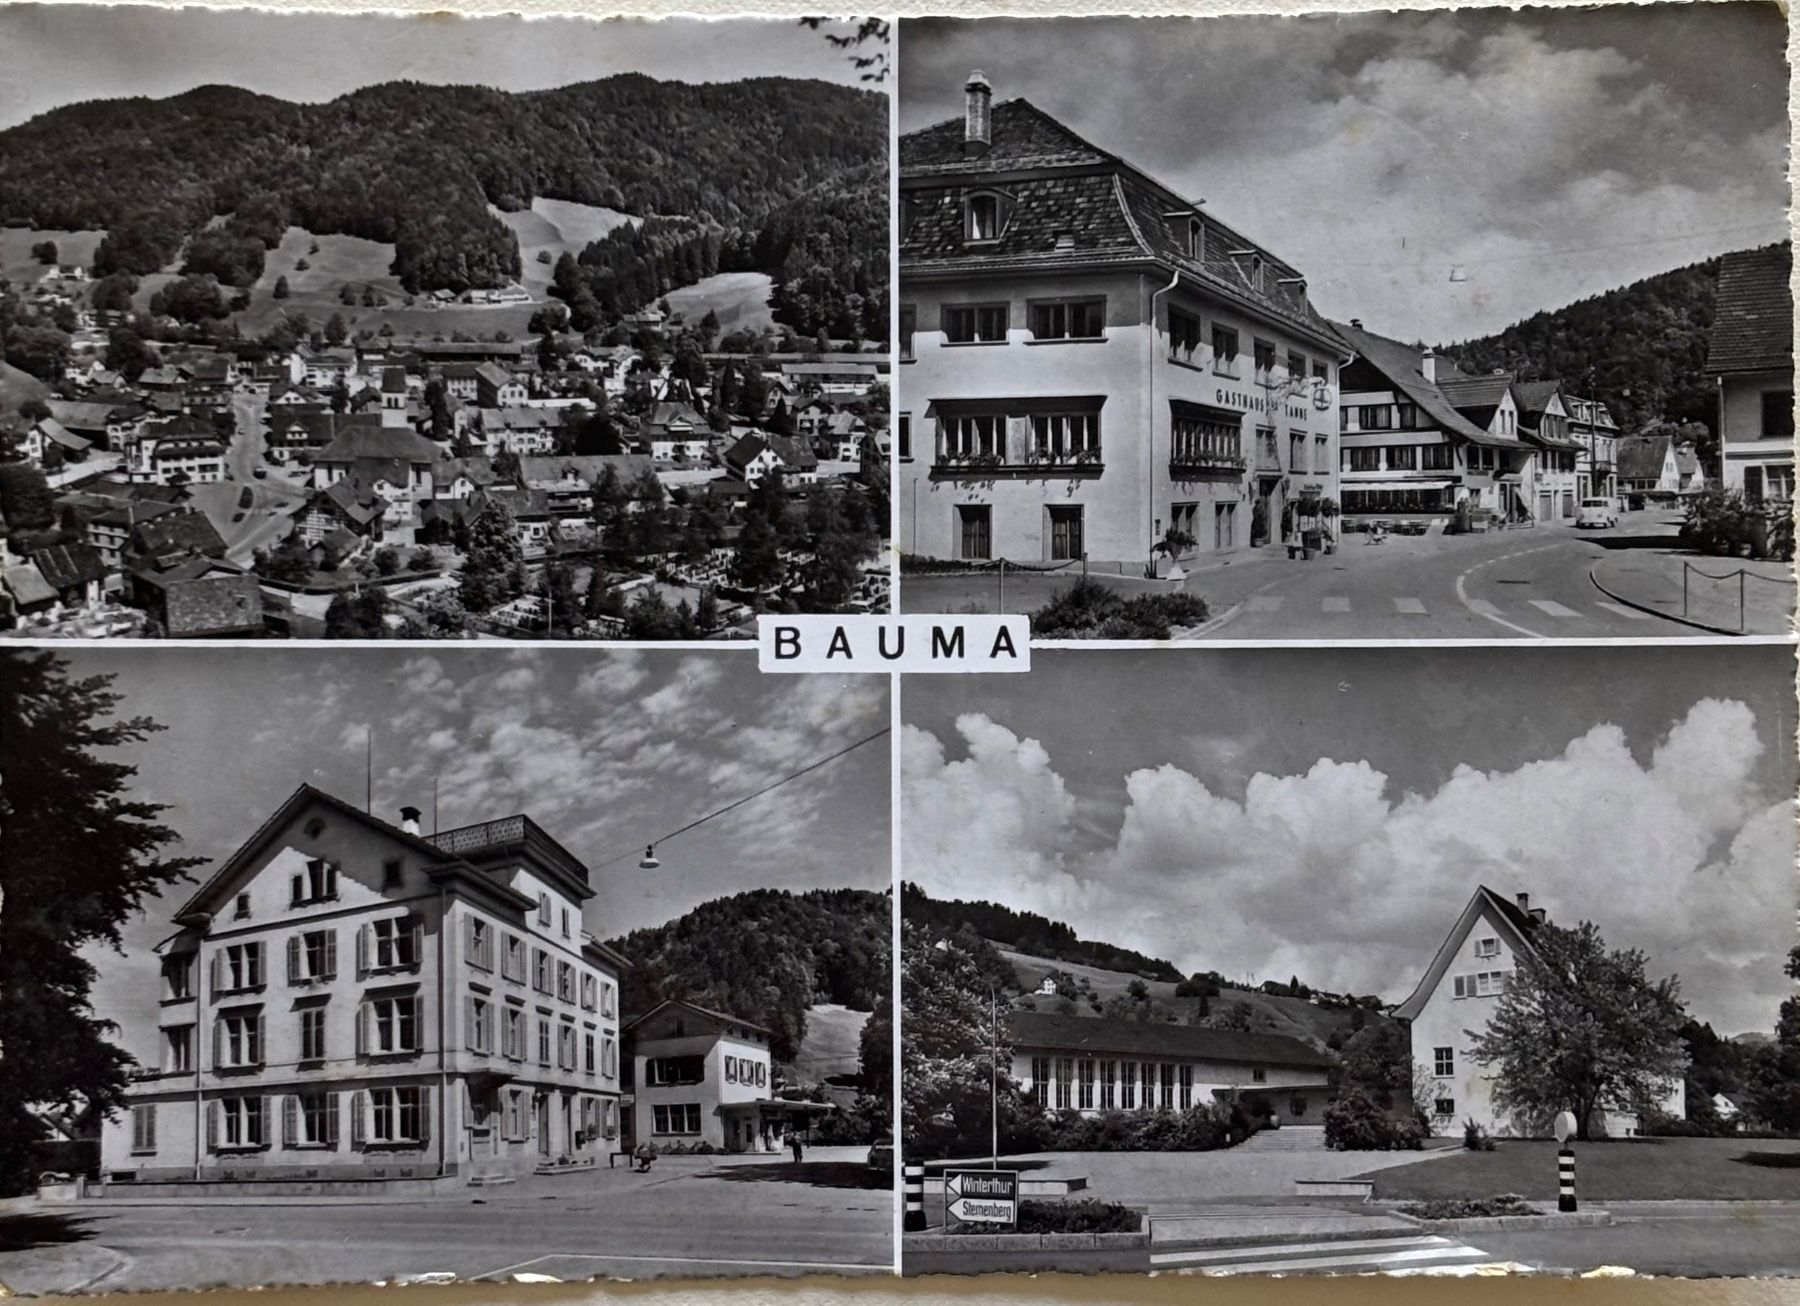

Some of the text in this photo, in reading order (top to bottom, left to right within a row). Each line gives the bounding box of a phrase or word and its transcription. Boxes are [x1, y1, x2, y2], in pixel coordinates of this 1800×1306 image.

[1216, 388, 1264, 412] GASTHAUS
[962, 1176, 1013, 1194] Winterthur
[962, 1200, 1012, 1221] Sternenberg
